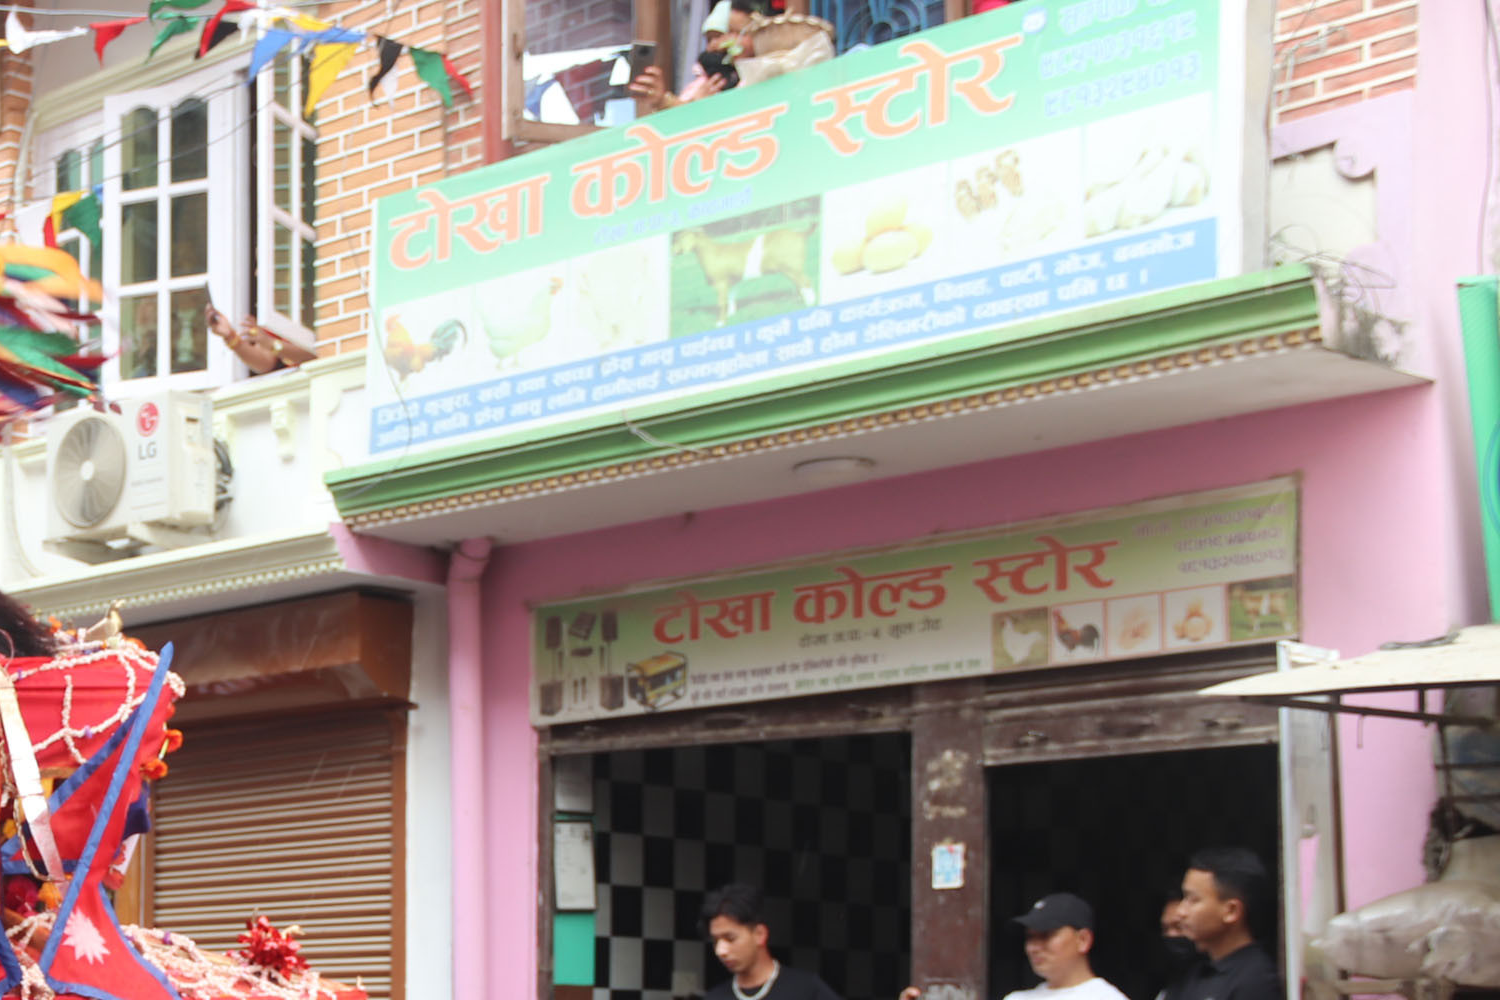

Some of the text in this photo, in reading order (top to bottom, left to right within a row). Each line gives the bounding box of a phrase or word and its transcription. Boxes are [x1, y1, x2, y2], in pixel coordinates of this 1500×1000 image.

[389, 36, 1021, 269] टोखा कोल्ड स्टोर
[138, 441, 158, 461] LG
[652, 589, 773, 644] टोखा
[793, 566, 952, 624] कोल्ड
[974, 536, 1119, 603] स्टोर
